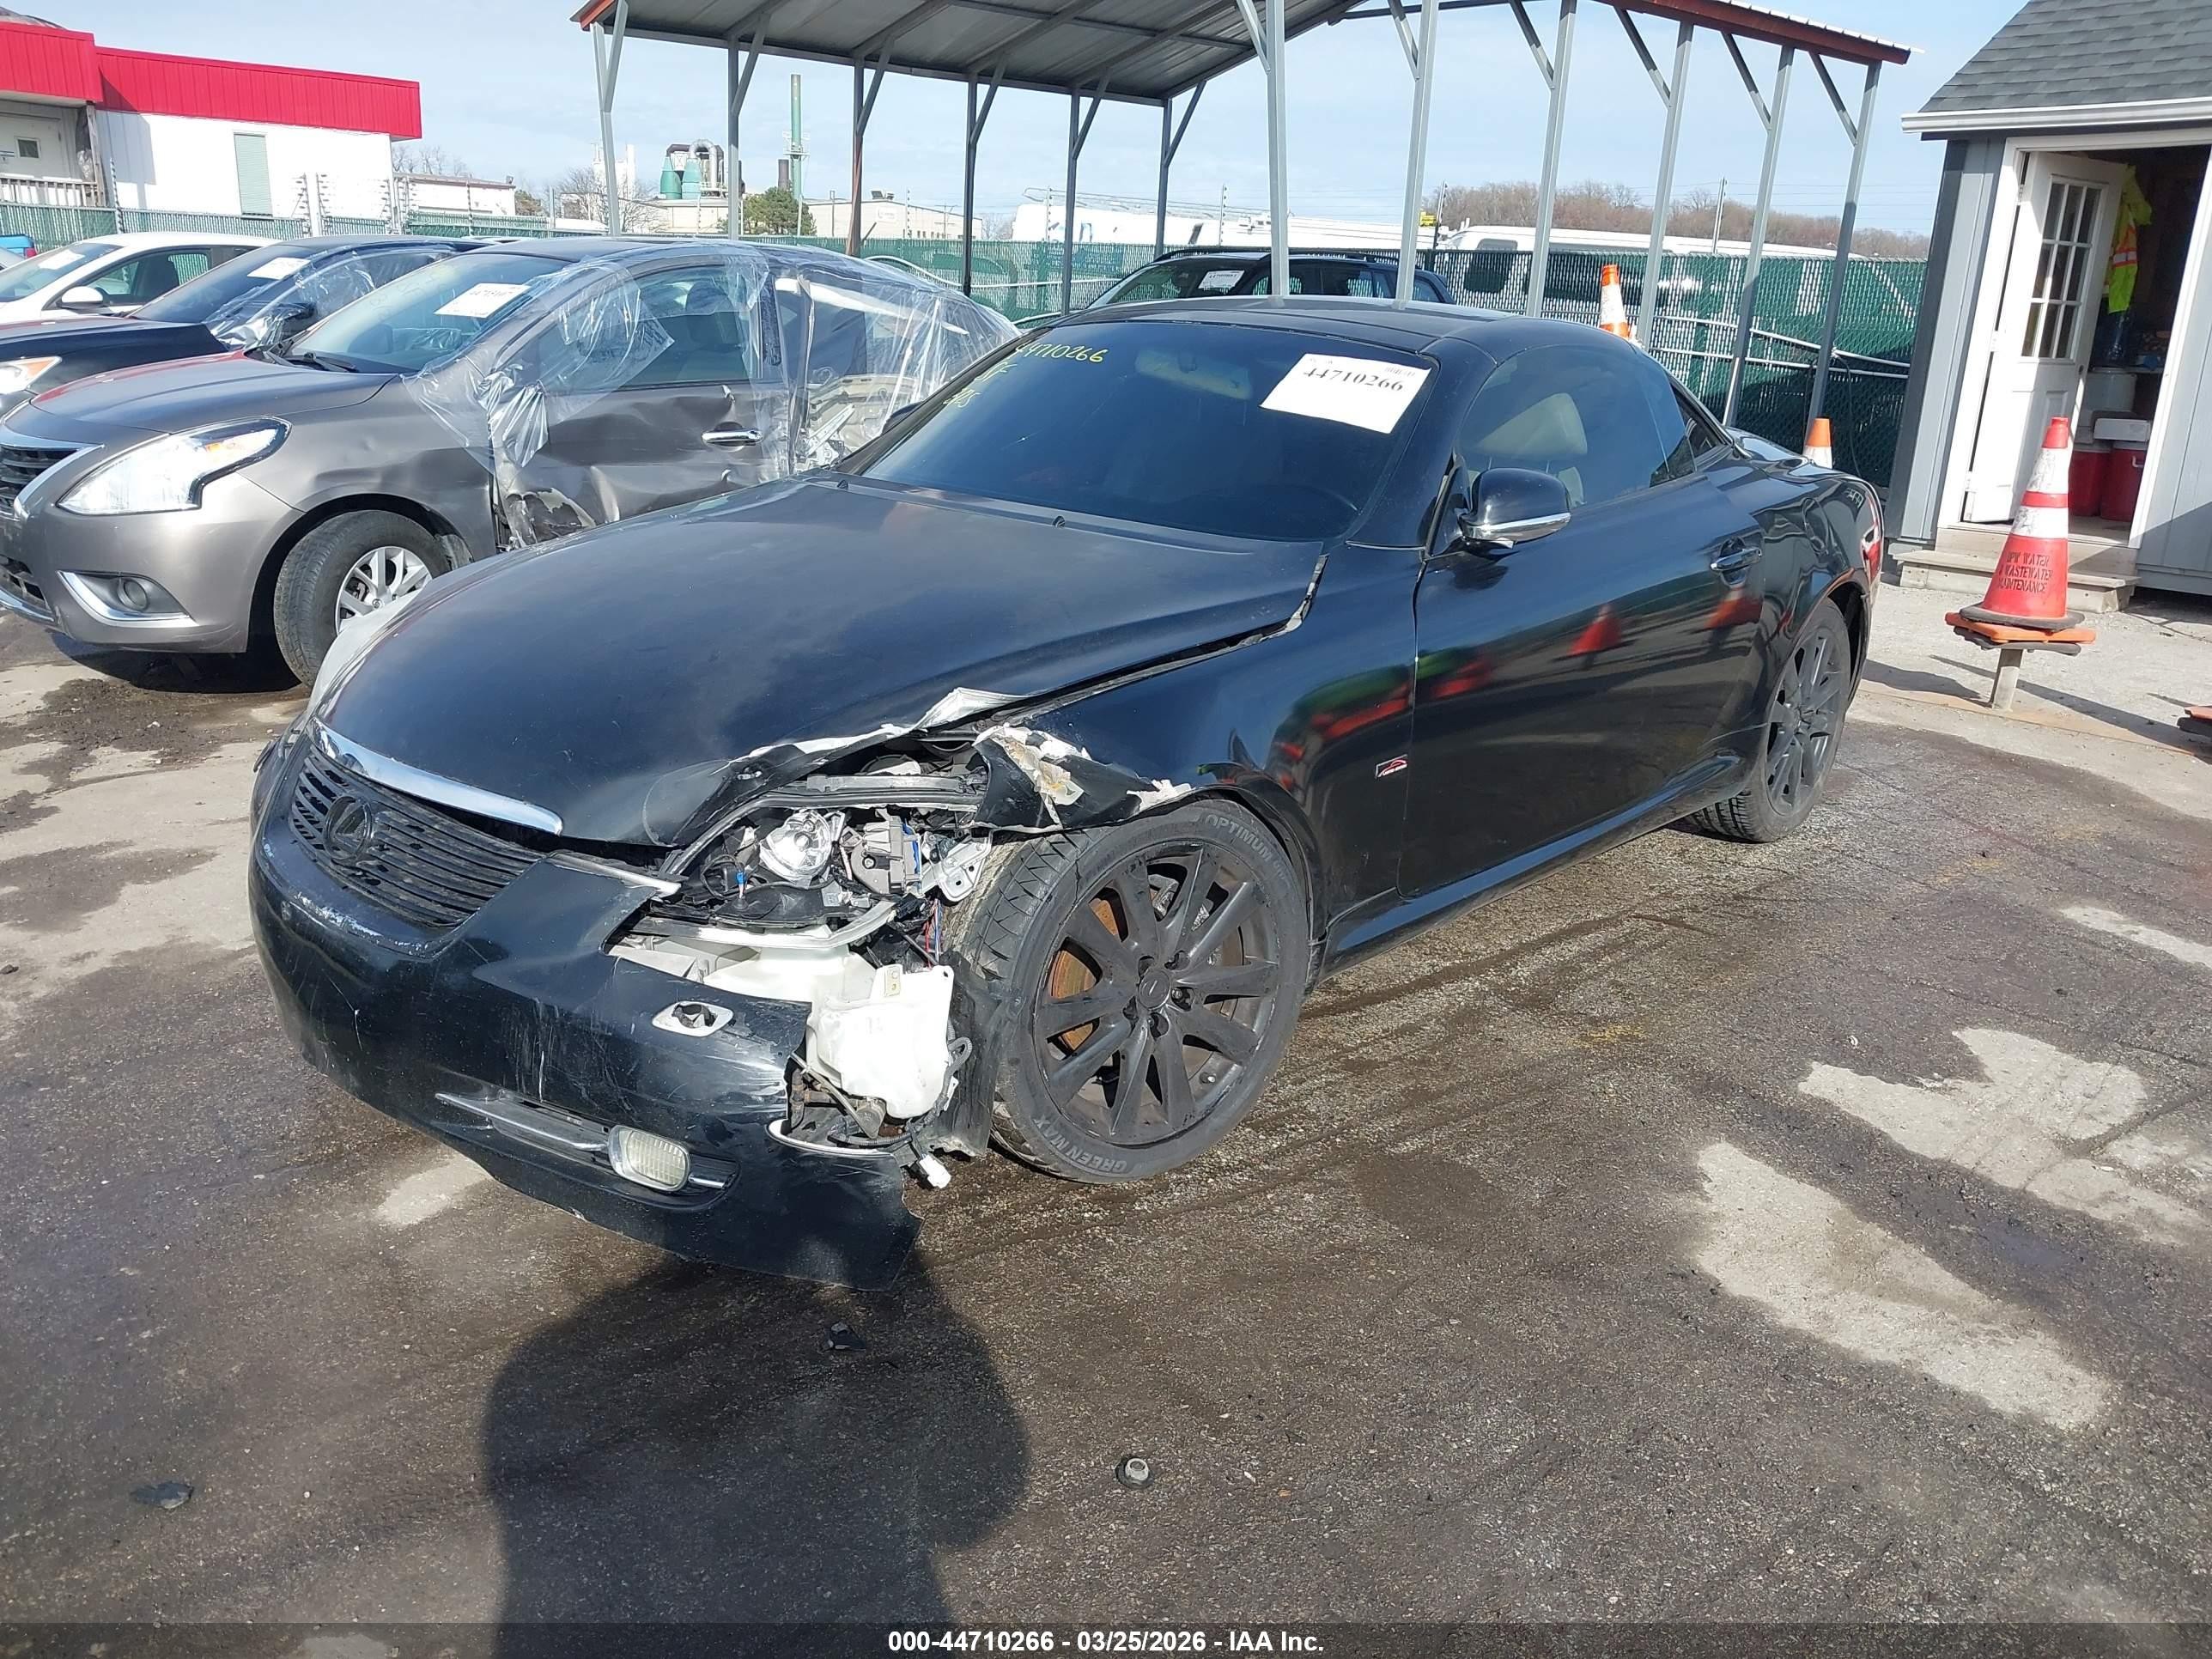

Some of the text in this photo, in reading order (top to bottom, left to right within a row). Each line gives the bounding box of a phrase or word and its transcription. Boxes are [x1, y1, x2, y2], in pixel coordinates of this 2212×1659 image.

[1007, 343, 1108, 362] 44710266
[1304, 367, 1403, 392] 44710266
[2023, 552, 2050, 568] WATER
[2004, 564, 2054, 581] WASTEWATER
[1998, 577, 2048, 594] MAINTENANCE
[1205, 814, 1273, 862] OPTIMUM
